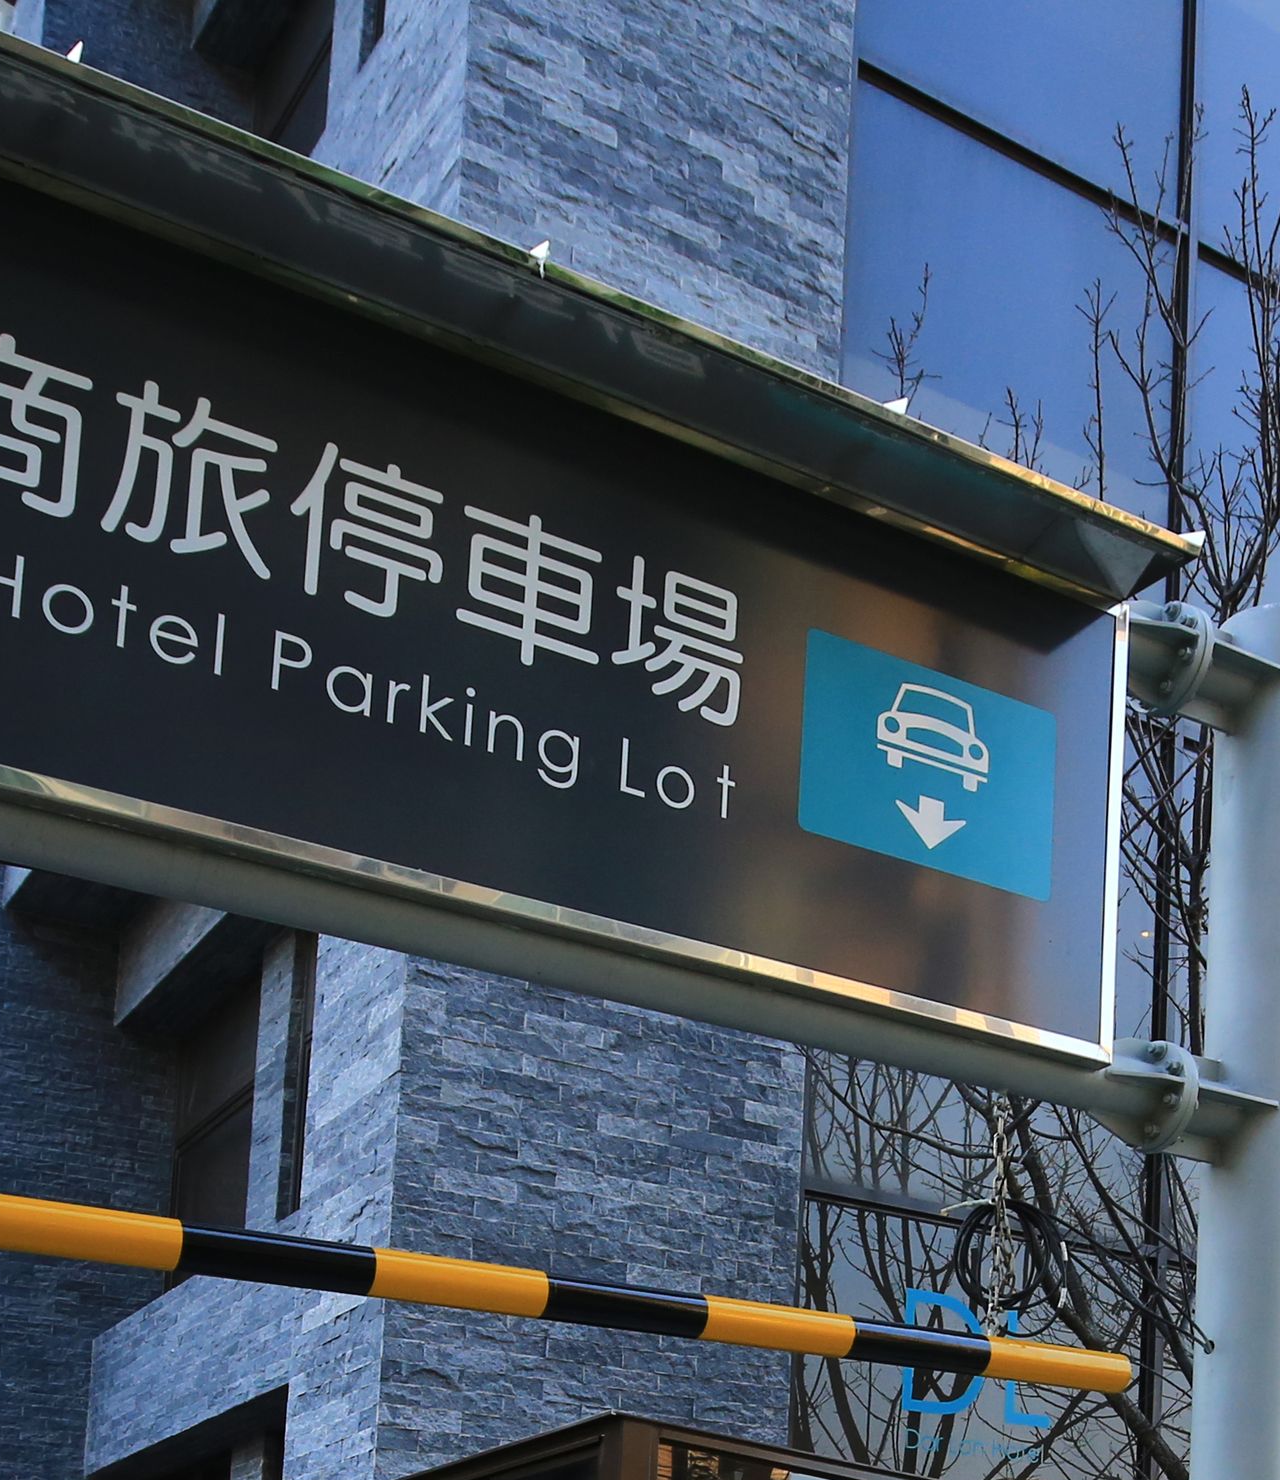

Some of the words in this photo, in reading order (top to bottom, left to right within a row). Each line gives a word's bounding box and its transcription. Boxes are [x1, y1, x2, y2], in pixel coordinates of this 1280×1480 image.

[271, 628, 580, 790] Parking
[619, 737, 736, 820] Lot
[901, 1286, 1052, 1429] DL
[904, 1428, 944, 1452] Dar
[991, 1439, 1046, 1464] Hotel
